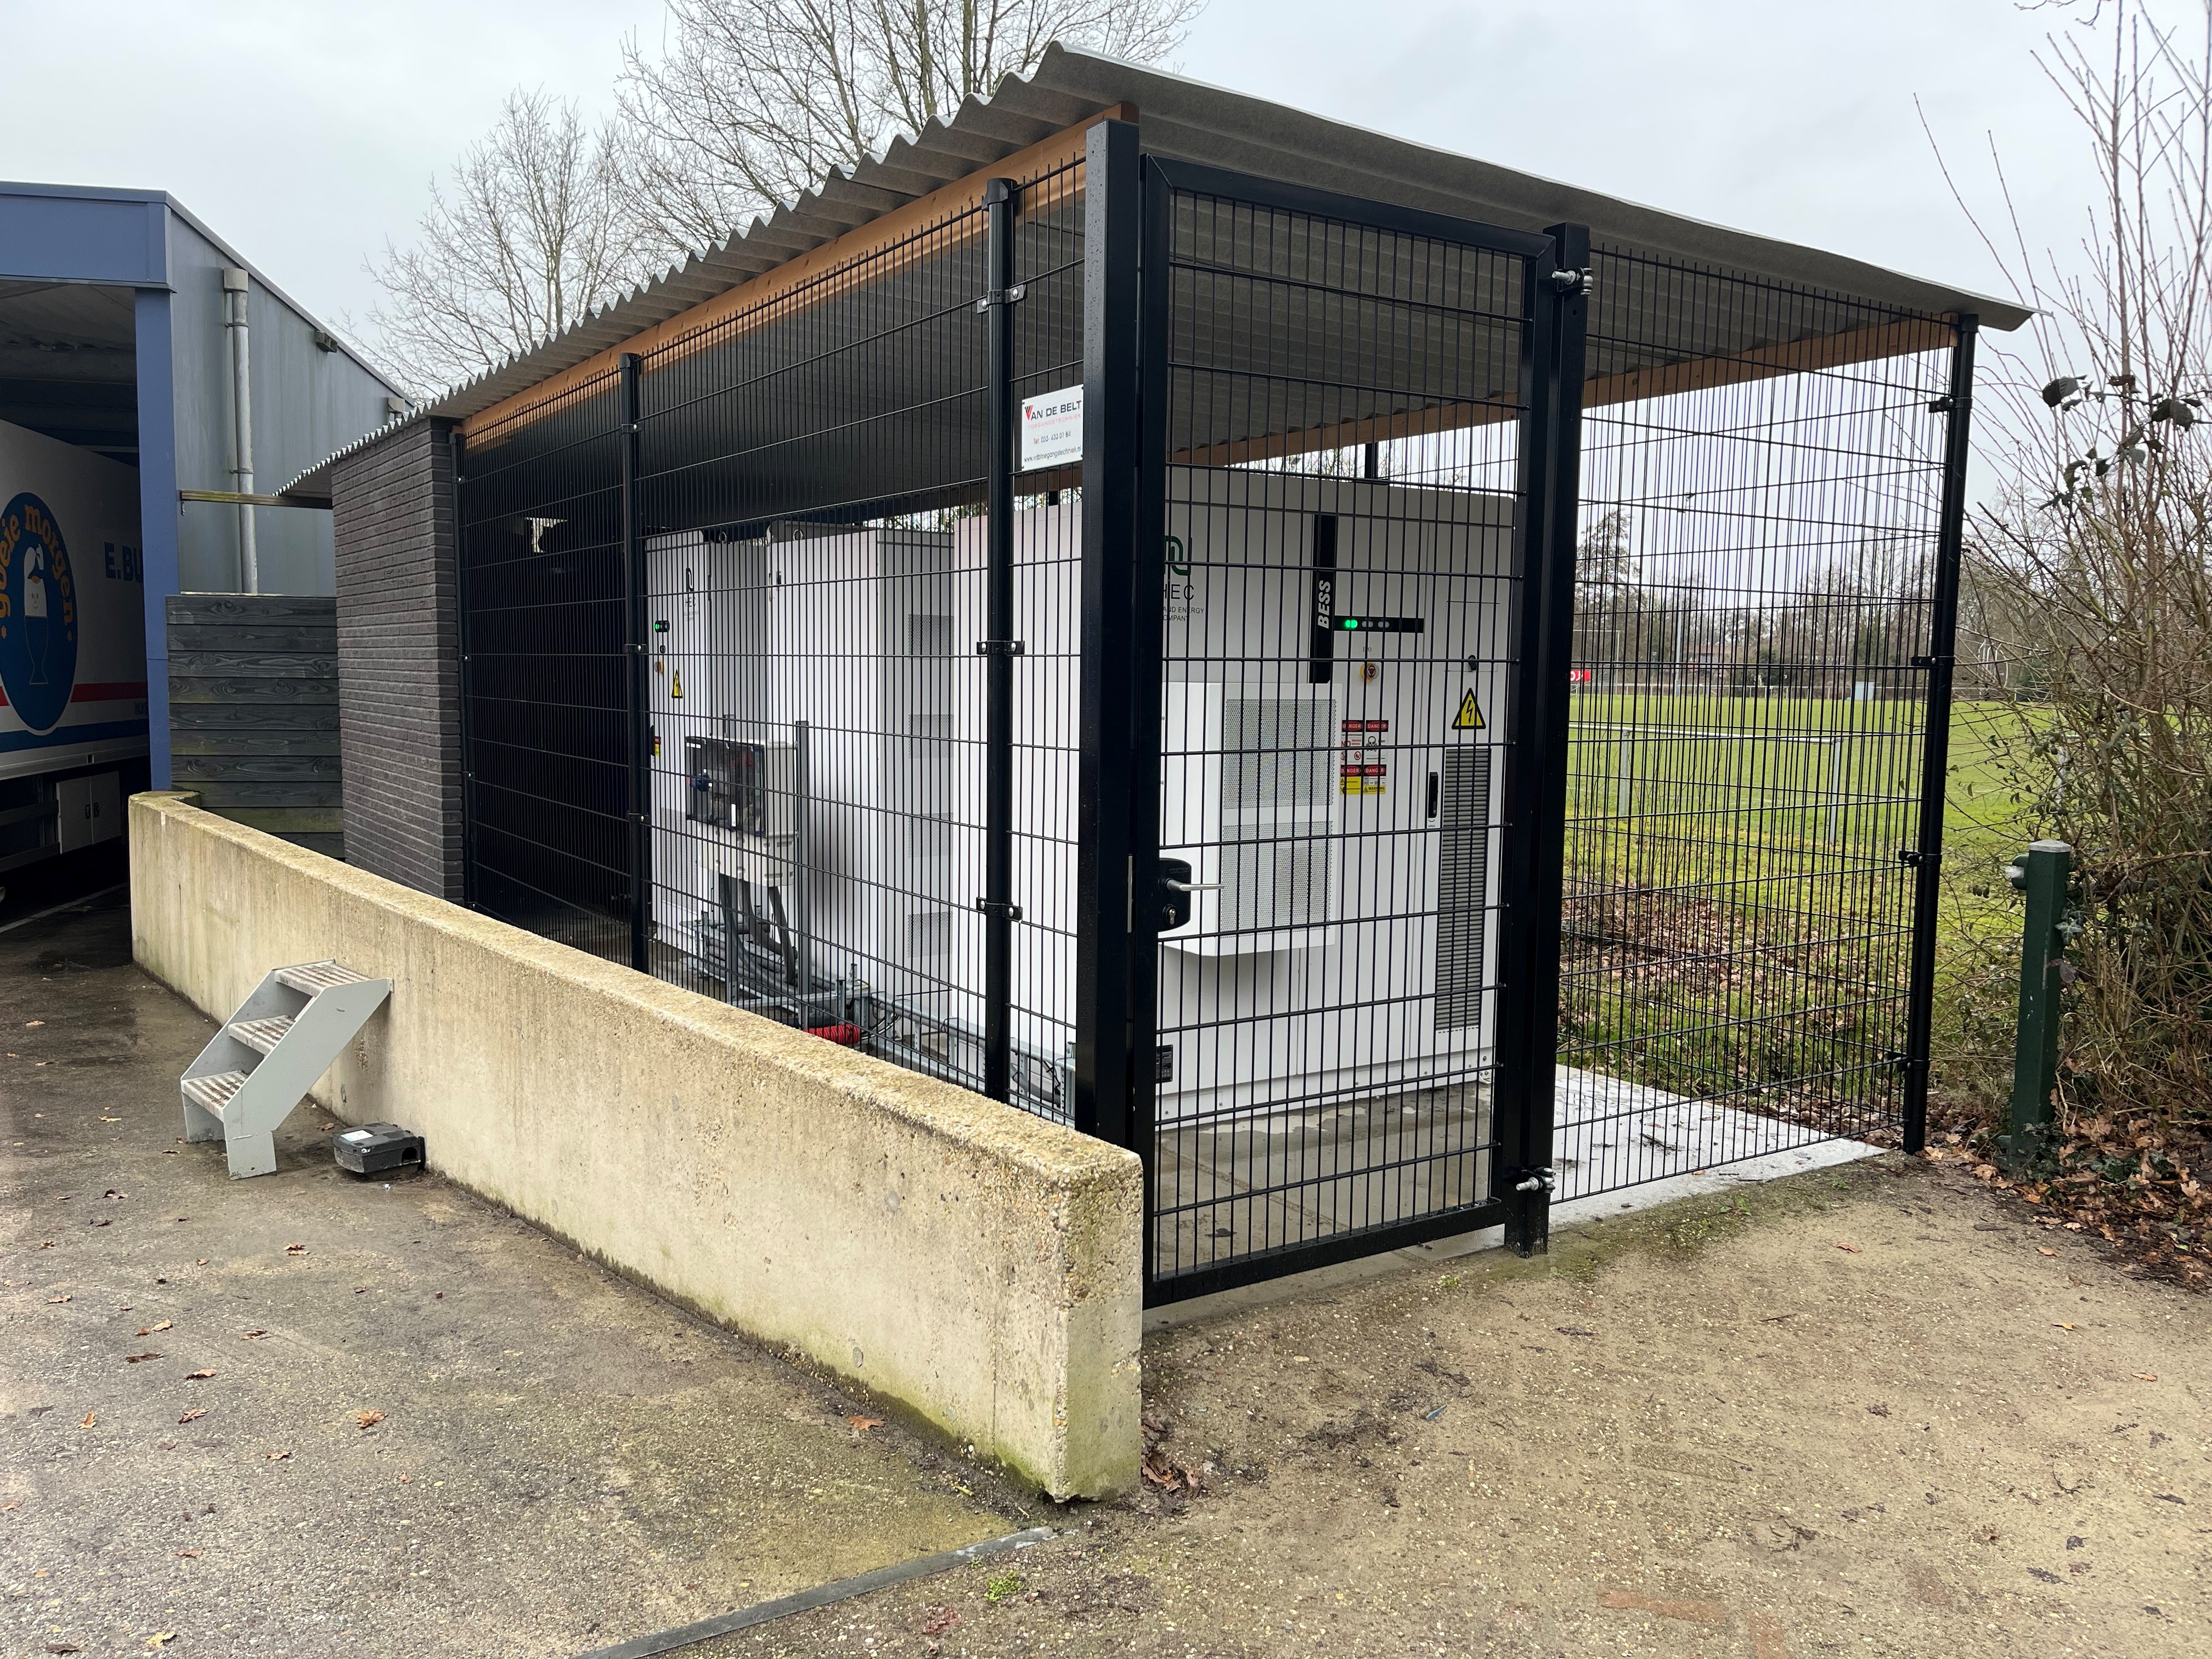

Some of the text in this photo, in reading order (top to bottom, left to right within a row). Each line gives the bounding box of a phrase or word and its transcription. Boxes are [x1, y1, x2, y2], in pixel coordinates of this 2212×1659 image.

[1024, 400, 1081, 421] VAN DE BELT
[24, 504, 74, 626] morgen
[1317, 580, 1331, 629] BESS
